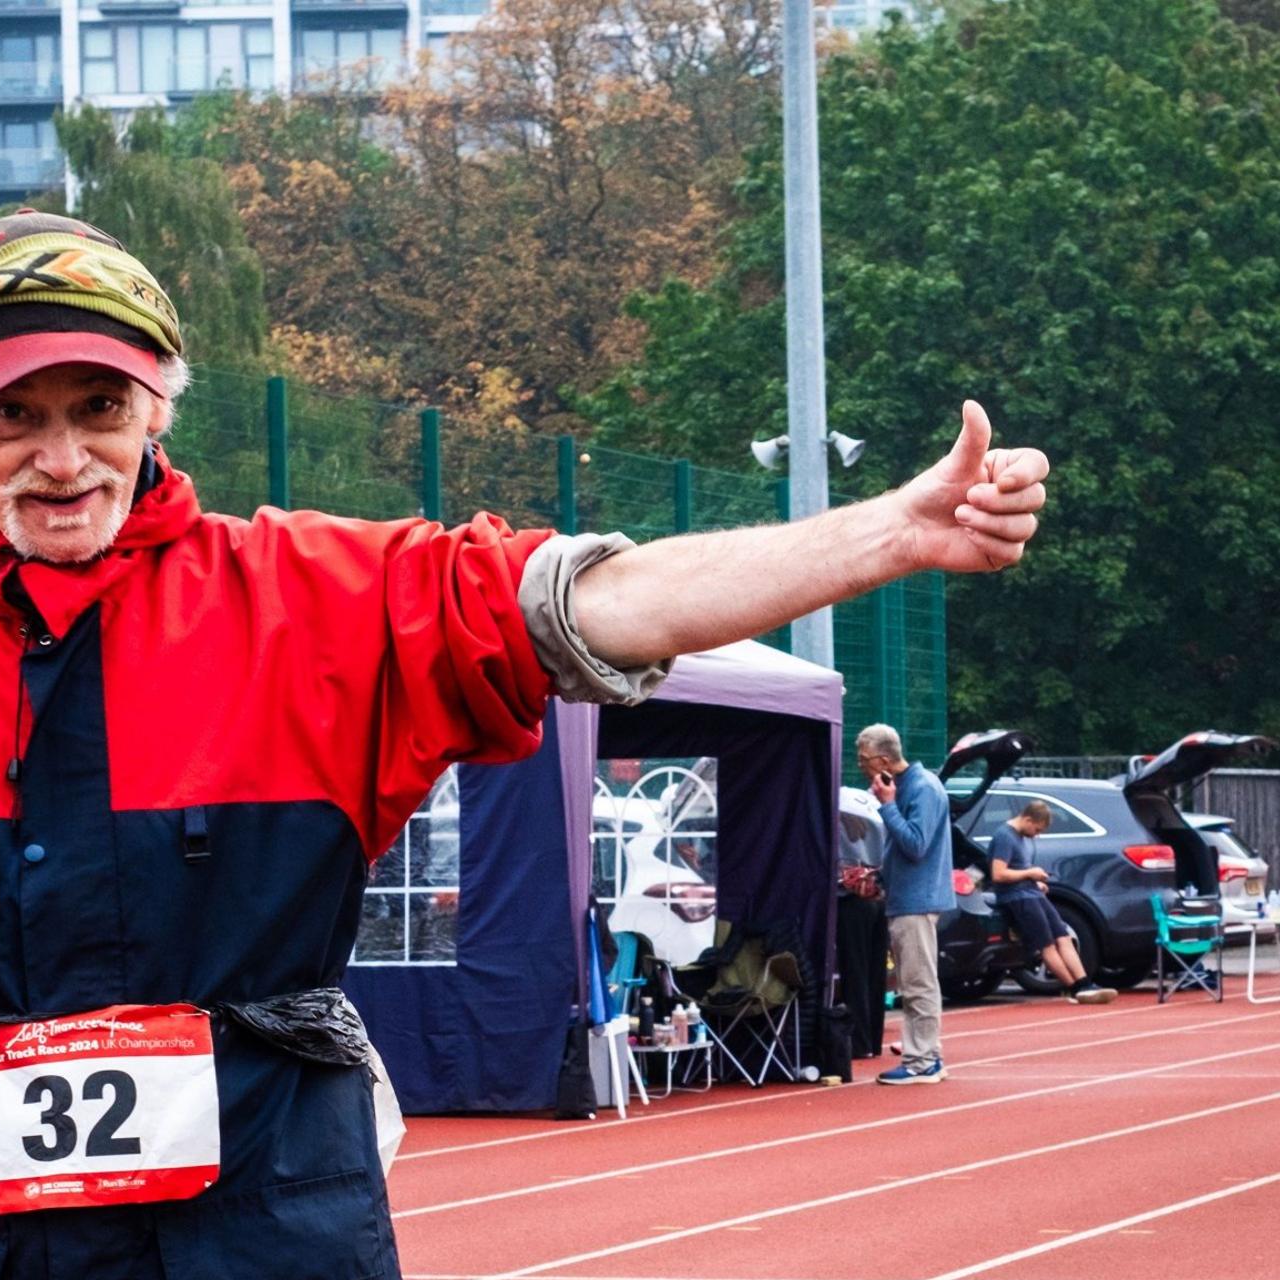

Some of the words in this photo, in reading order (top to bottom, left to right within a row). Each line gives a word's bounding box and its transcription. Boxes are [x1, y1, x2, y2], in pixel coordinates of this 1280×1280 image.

[5, 1046, 36, 1061] Track
[37, 1044, 66, 1056] Race
[68, 1040, 99, 1052] 2024
[101, 1040, 117, 1050] UK
[118, 1036, 196, 1050] Championships
[21, 1069, 141, 1162] 32
